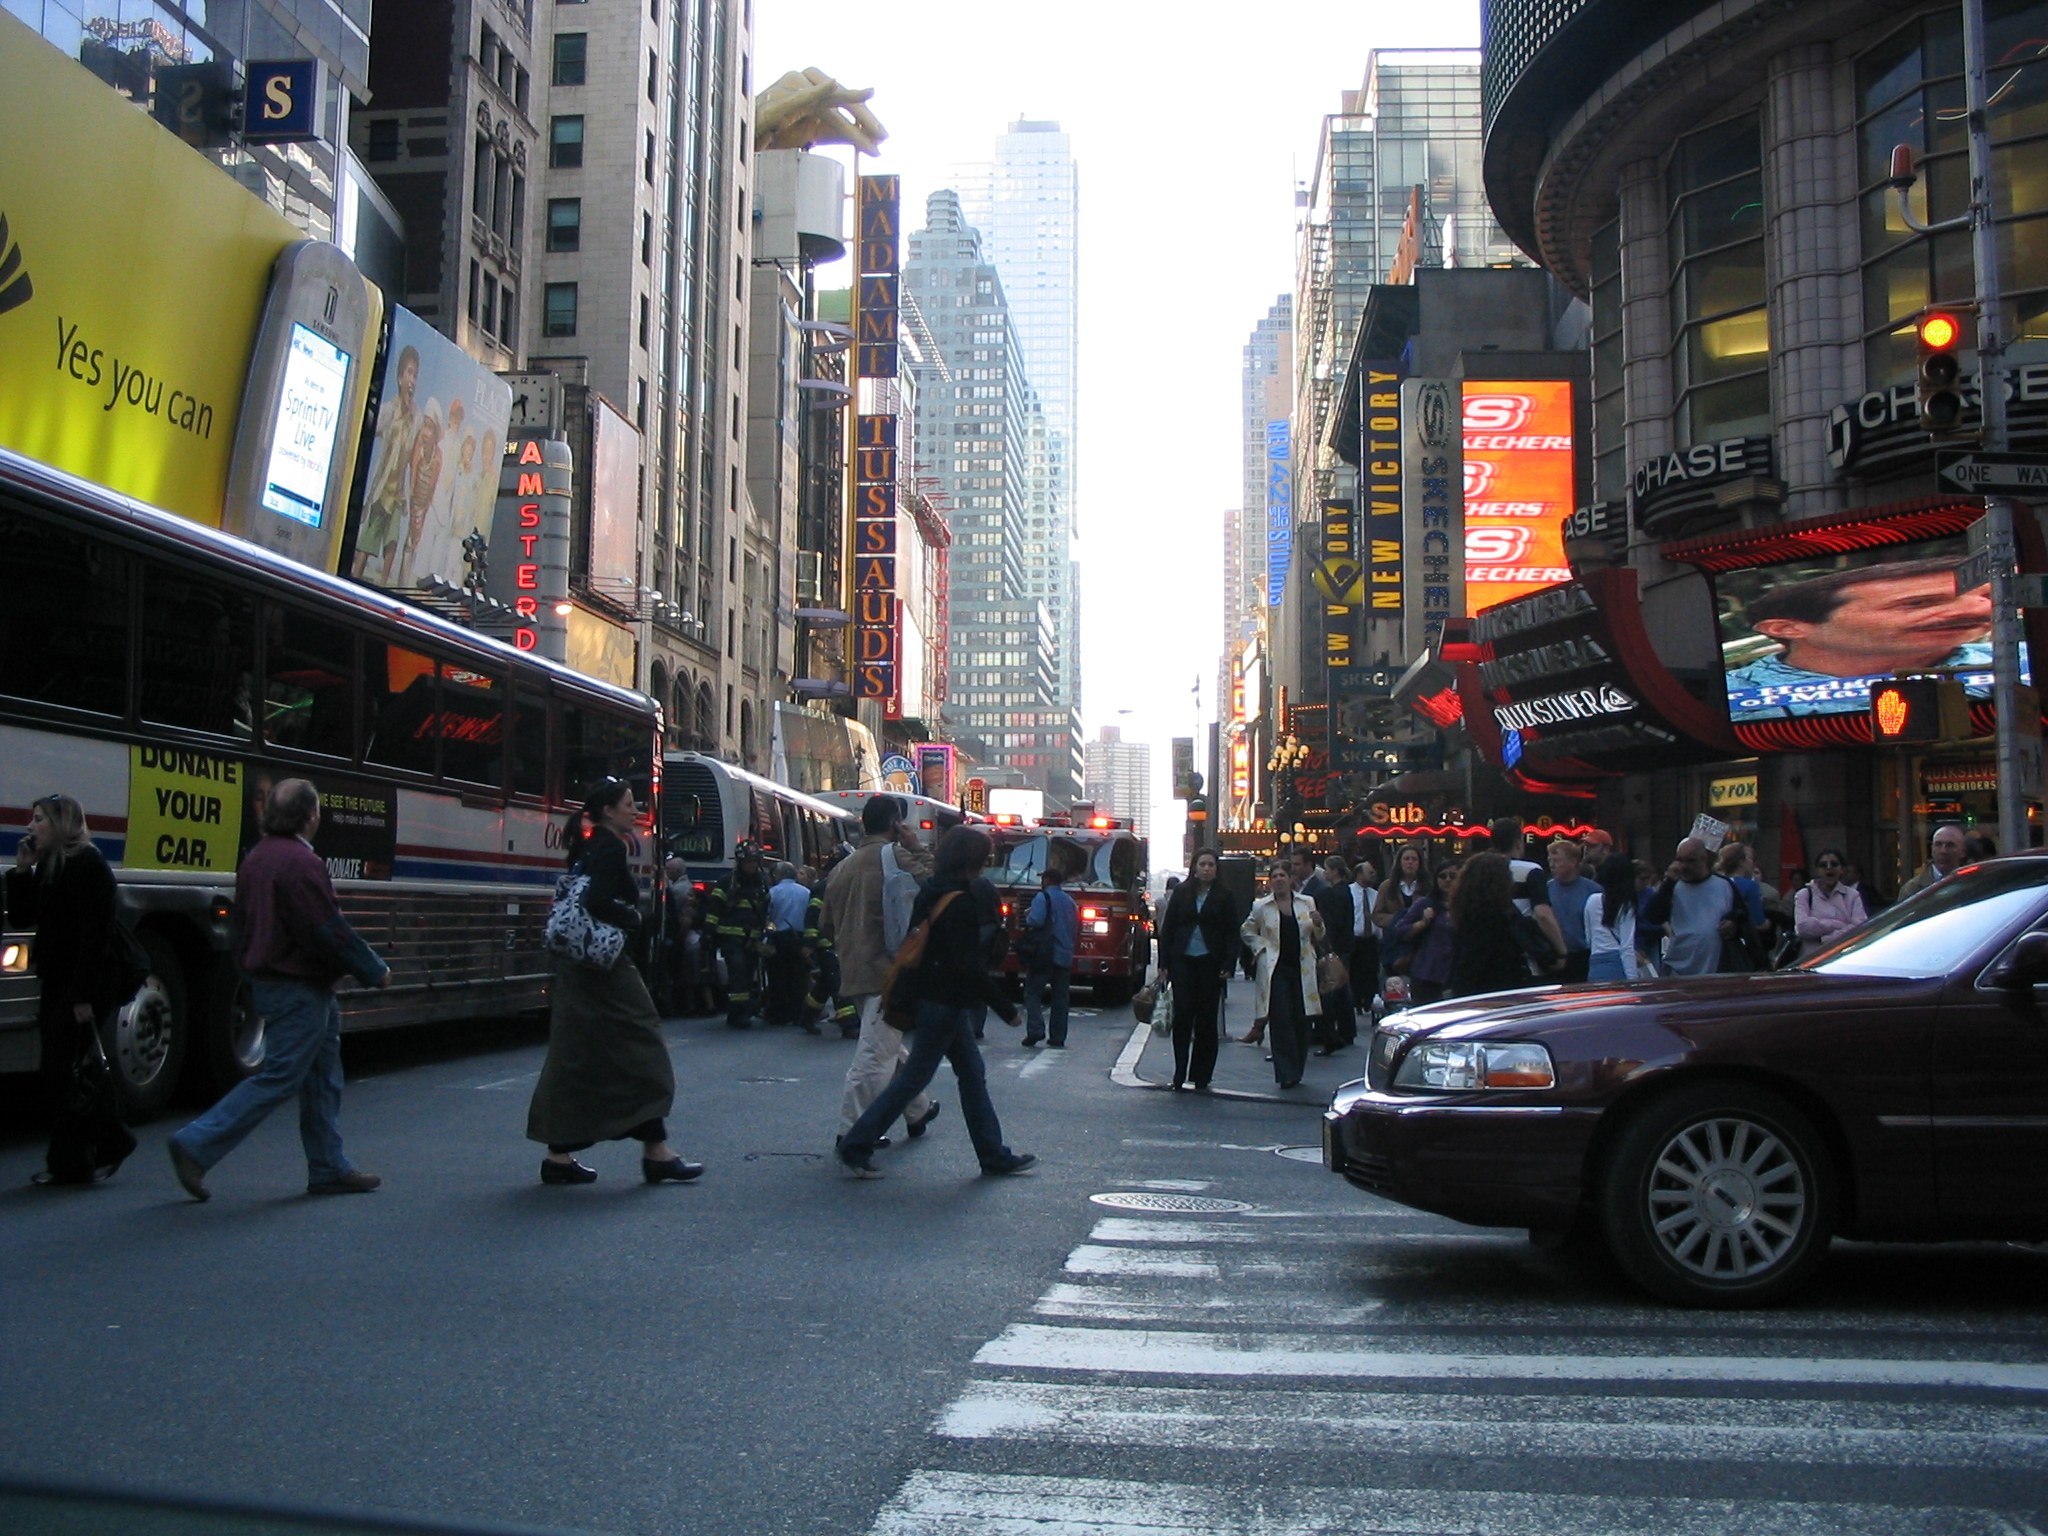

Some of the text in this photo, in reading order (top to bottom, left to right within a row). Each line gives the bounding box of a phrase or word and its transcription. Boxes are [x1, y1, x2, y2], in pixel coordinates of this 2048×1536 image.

[264, 77, 293, 119] S
[57, 316, 213, 439] Yes you can
[286, 388, 334, 431] Sprint TV
[294, 424, 316, 452] Live
[502, 441, 519, 454] EW
[860, 176, 895, 696] MADAME TUSSAUD'S
[1268, 420, 1290, 460] NEW
[1634, 437, 1747, 498] CHASE
[1956, 464, 1991, 482] ONE
[1369, 370, 1401, 609] NEW VICTORY
[1563, 501, 1608, 542] ASE
[1268, 529, 1291, 606] STUDIOS
[1327, 632, 1349, 667] EW
[1494, 689, 1604, 732] QUIKSILVER
[141, 745, 236, 784] DONATE
[156, 787, 222, 825] YOUR
[330, 793, 343, 809] SEE
[345, 795, 358, 811] THE
[1928, 780, 1997, 793] BOARDRIDERS
[156, 834, 211, 867] CAR.
[326, 857, 361, 879] DONATE
